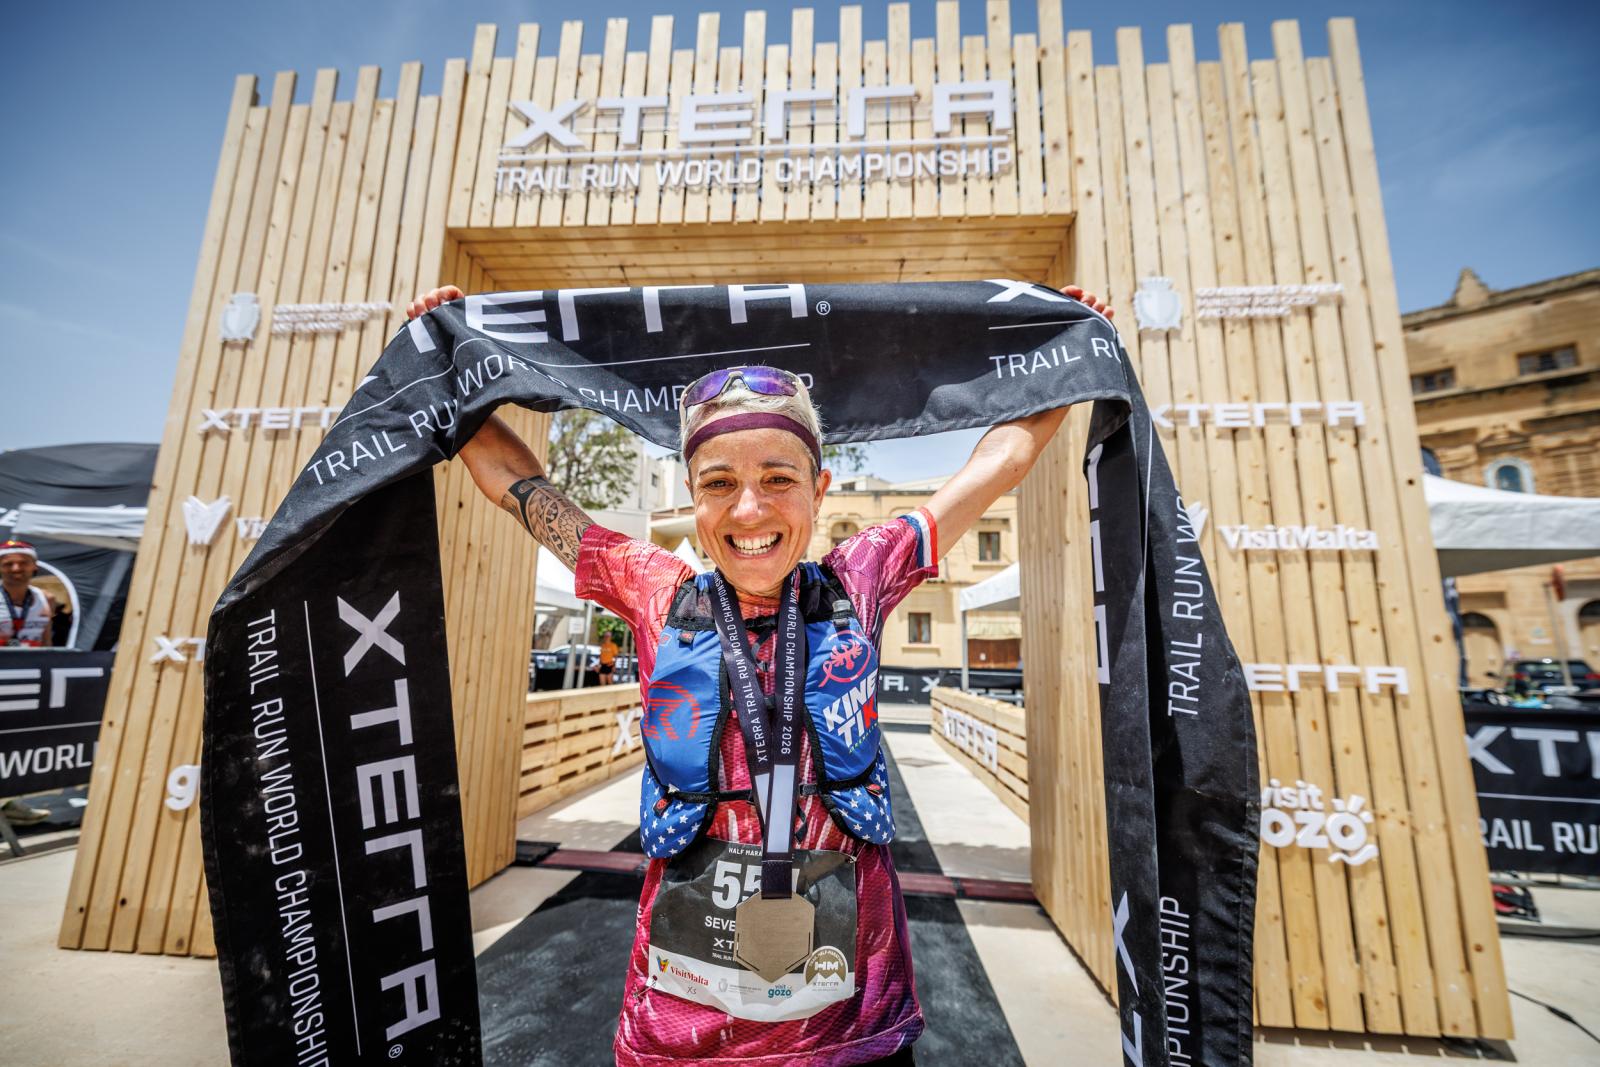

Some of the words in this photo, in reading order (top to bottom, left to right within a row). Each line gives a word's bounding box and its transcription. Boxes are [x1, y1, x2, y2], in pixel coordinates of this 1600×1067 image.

[504, 80, 1012, 150] XTERRA
[496, 166, 571, 193] TRAIL
[581, 161, 641, 187] RUN
[656, 157, 761, 186] WORLD
[775, 147, 1011, 182] CHAMPIONSHIP
[989, 345, 1081, 379] TRAIL
[307, 431, 407, 485] TRAIL
[409, 399, 458, 438] RU
[1219, 524, 1379, 550] VisitMalta
[1172, 556, 1203, 619] RUN
[727, 624, 744, 657] WORLD
[787, 606, 797, 639] WORLD
[247, 609, 280, 695] TRAIL
[735, 658, 749, 680] RUN
[1168, 618, 1203, 715] TRAIL
[742, 682, 758, 715] TRAIL
[783, 641, 796, 722] CHAMPIONSHIP
[823, 668, 878, 733] KINE
[251, 697, 289, 761] RUN
[751, 716, 768, 763] XTERRA
[781, 726, 792, 755] 2026
[0, 742, 99, 779] WORL
[260, 763, 304, 866] WORLD
[337, 591, 441, 1042] XTERRA
[728, 847, 745, 855] HALF
[670, 965, 709, 986] VisitMalta
[767, 988, 792, 998] gozo
